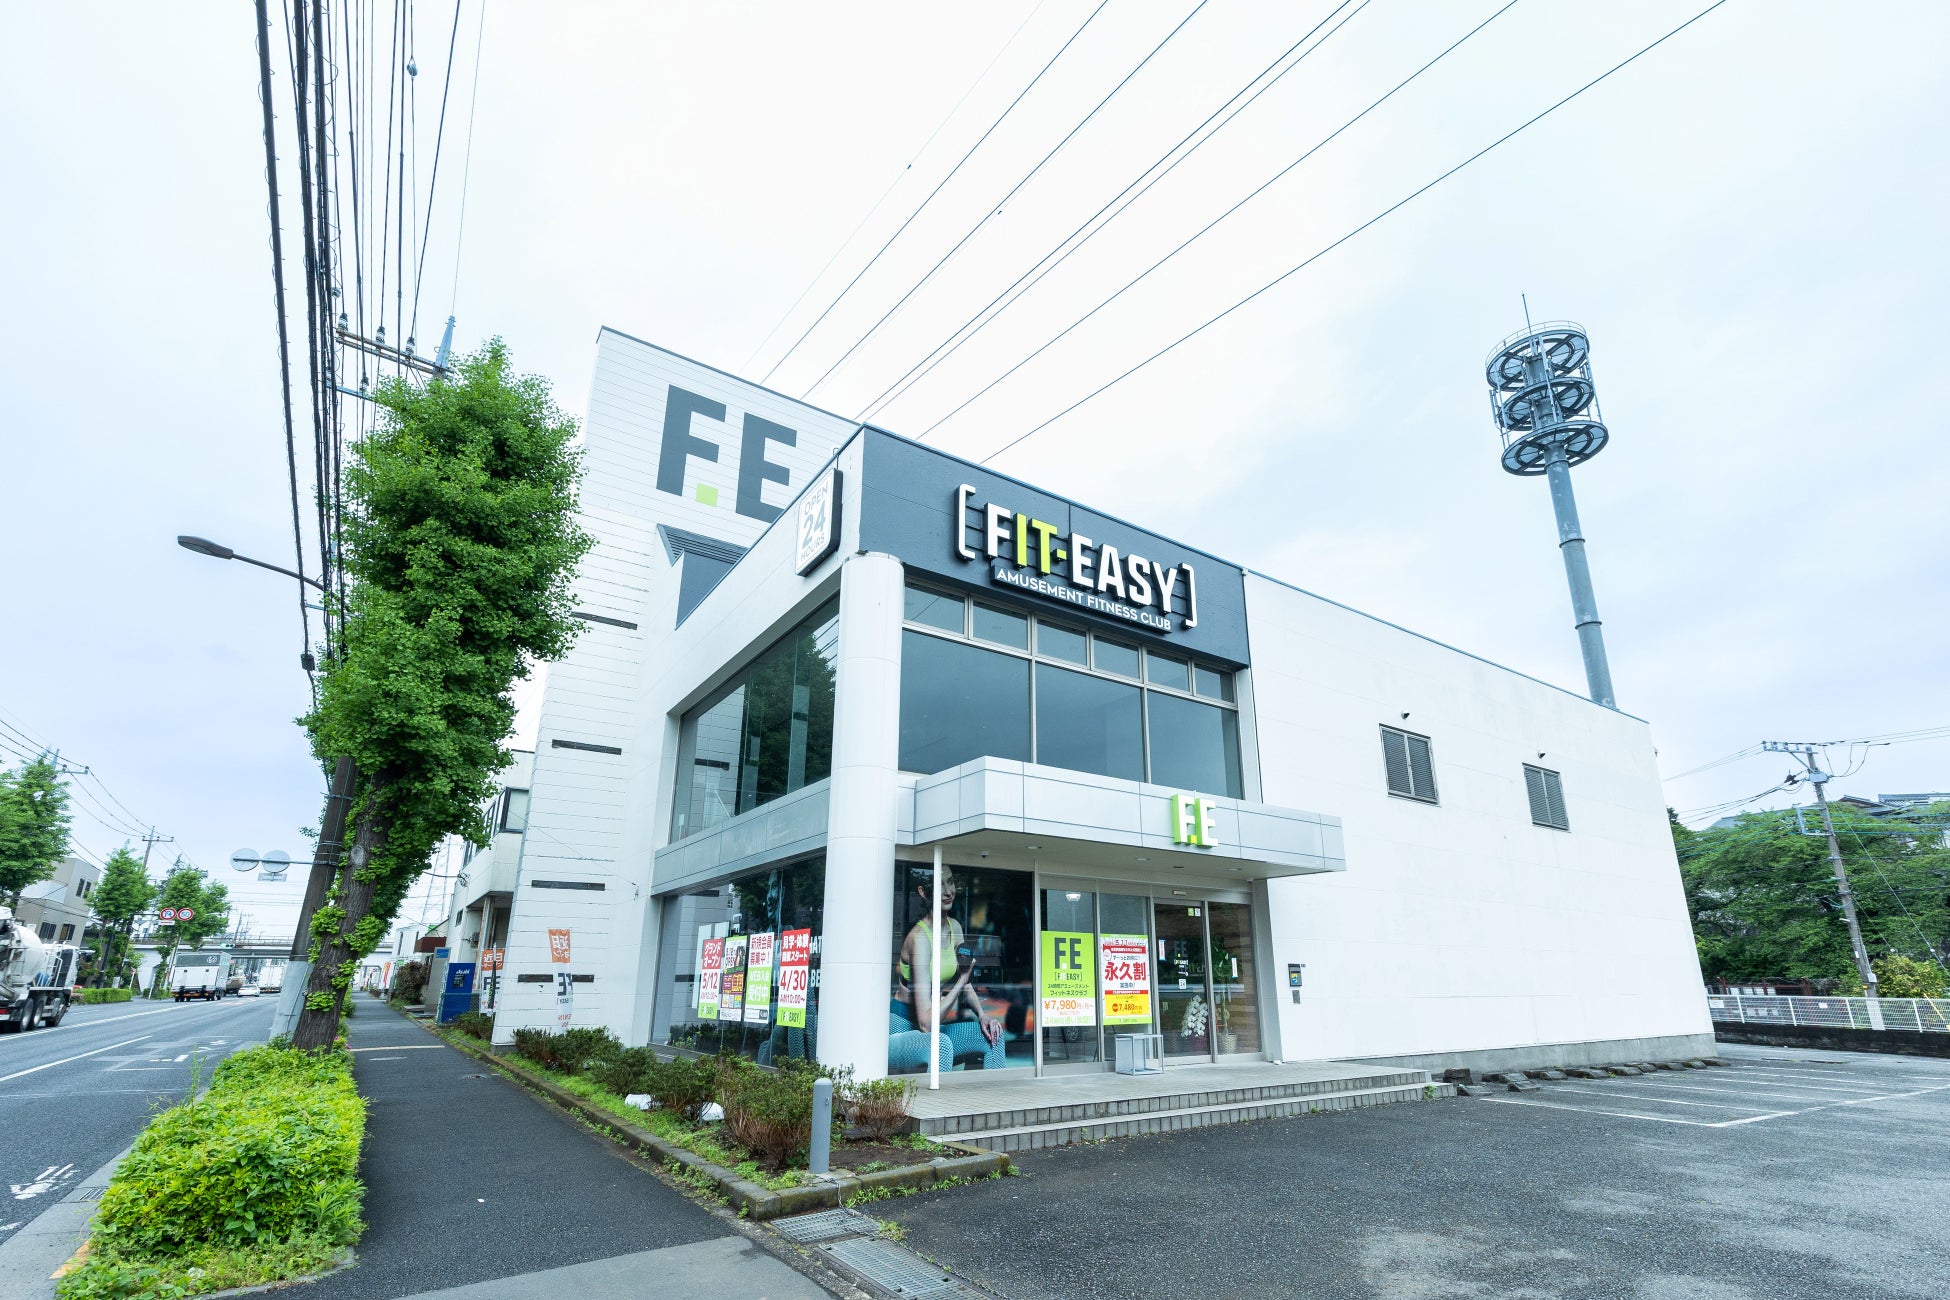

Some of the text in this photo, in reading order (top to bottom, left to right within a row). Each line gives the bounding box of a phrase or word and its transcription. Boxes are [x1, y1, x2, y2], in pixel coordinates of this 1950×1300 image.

[804, 482, 829, 515] OPEN
[802, 500, 826, 549] 24
[800, 533, 826, 562] HOURS
[996, 568, 1172, 631] AMUSEMENT FITNESS CLUB
[704, 941, 722, 956] グランド
[751, 936, 773, 951] 新規会員
[783, 934, 809, 950] 見学・体験
[703, 955, 721, 968] オープン
[702, 972, 718, 990] 5/12
[780, 969, 807, 991] 4/30
[1104, 961, 1148, 982] 永久割
[748, 984, 768, 1002] 受付中
